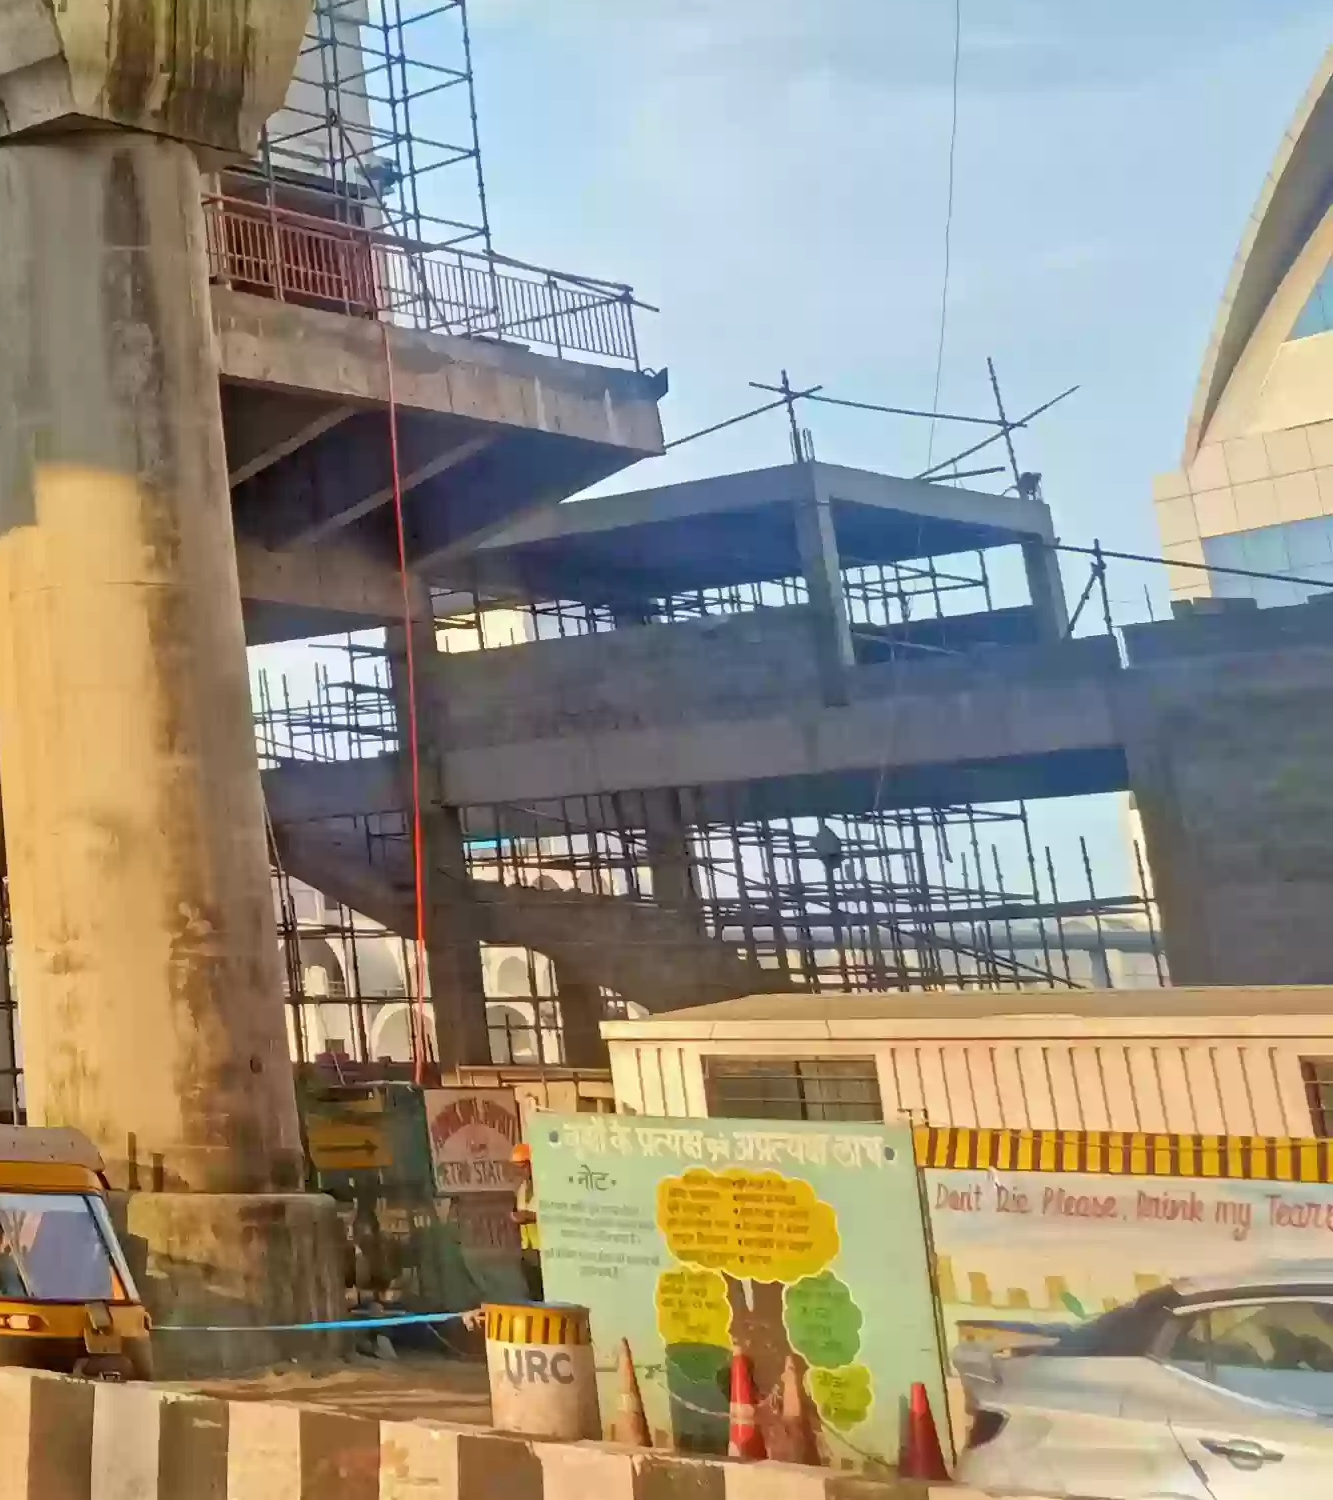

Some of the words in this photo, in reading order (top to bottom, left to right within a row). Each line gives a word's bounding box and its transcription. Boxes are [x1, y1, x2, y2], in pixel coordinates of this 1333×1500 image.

[577, 1164, 610, 1191] नोट
[1215, 1201, 1252, 1242] my
[503, 1348, 574, 1386] URC
